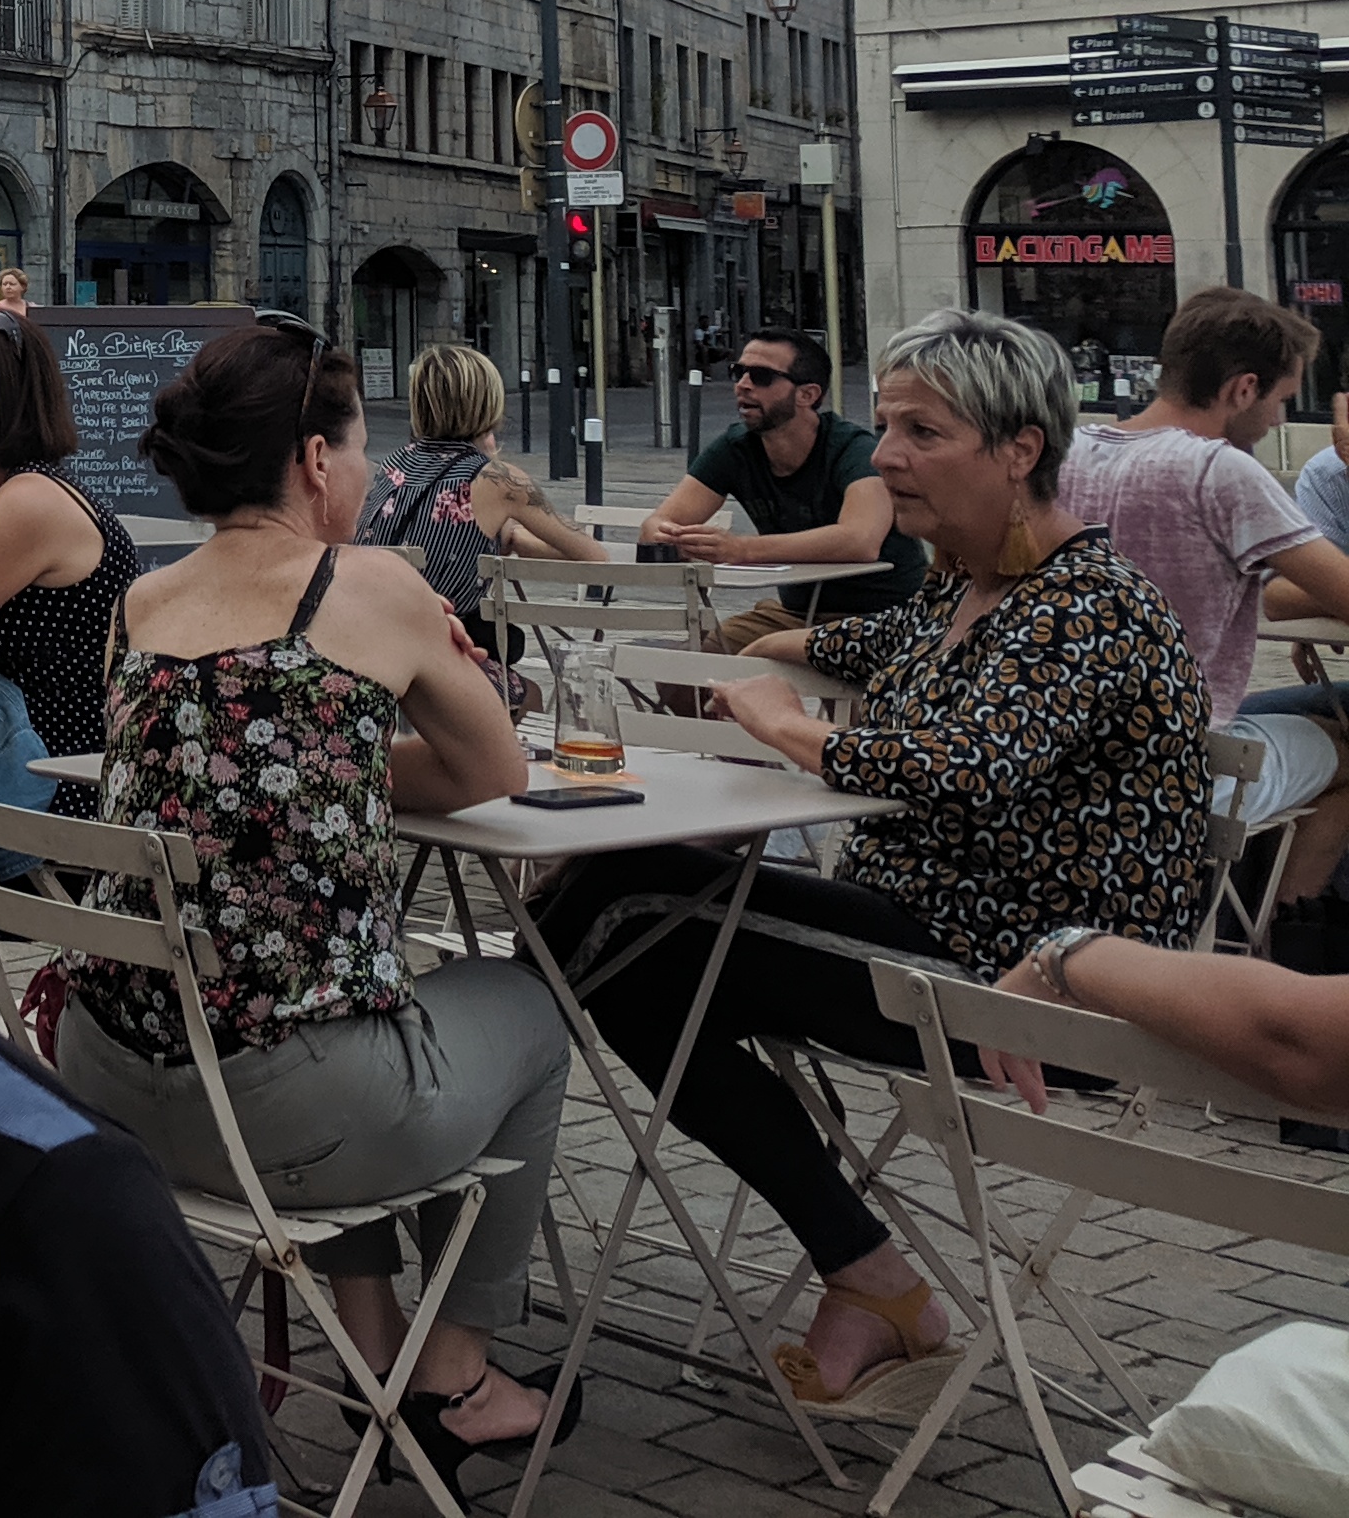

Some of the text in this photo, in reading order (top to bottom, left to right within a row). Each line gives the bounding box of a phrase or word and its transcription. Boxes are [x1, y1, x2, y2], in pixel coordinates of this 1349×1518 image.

[1086, 39, 1114, 49] Place
[1116, 58, 1139, 68] Fort
[1088, 86, 1105, 97] Les
[1139, 82, 1184, 93] Douches
[1105, 111, 1145, 121] Urinoirs
[137, 203, 194, 216] LA POSTE
[1294, 283, 1342, 303] OPEN
